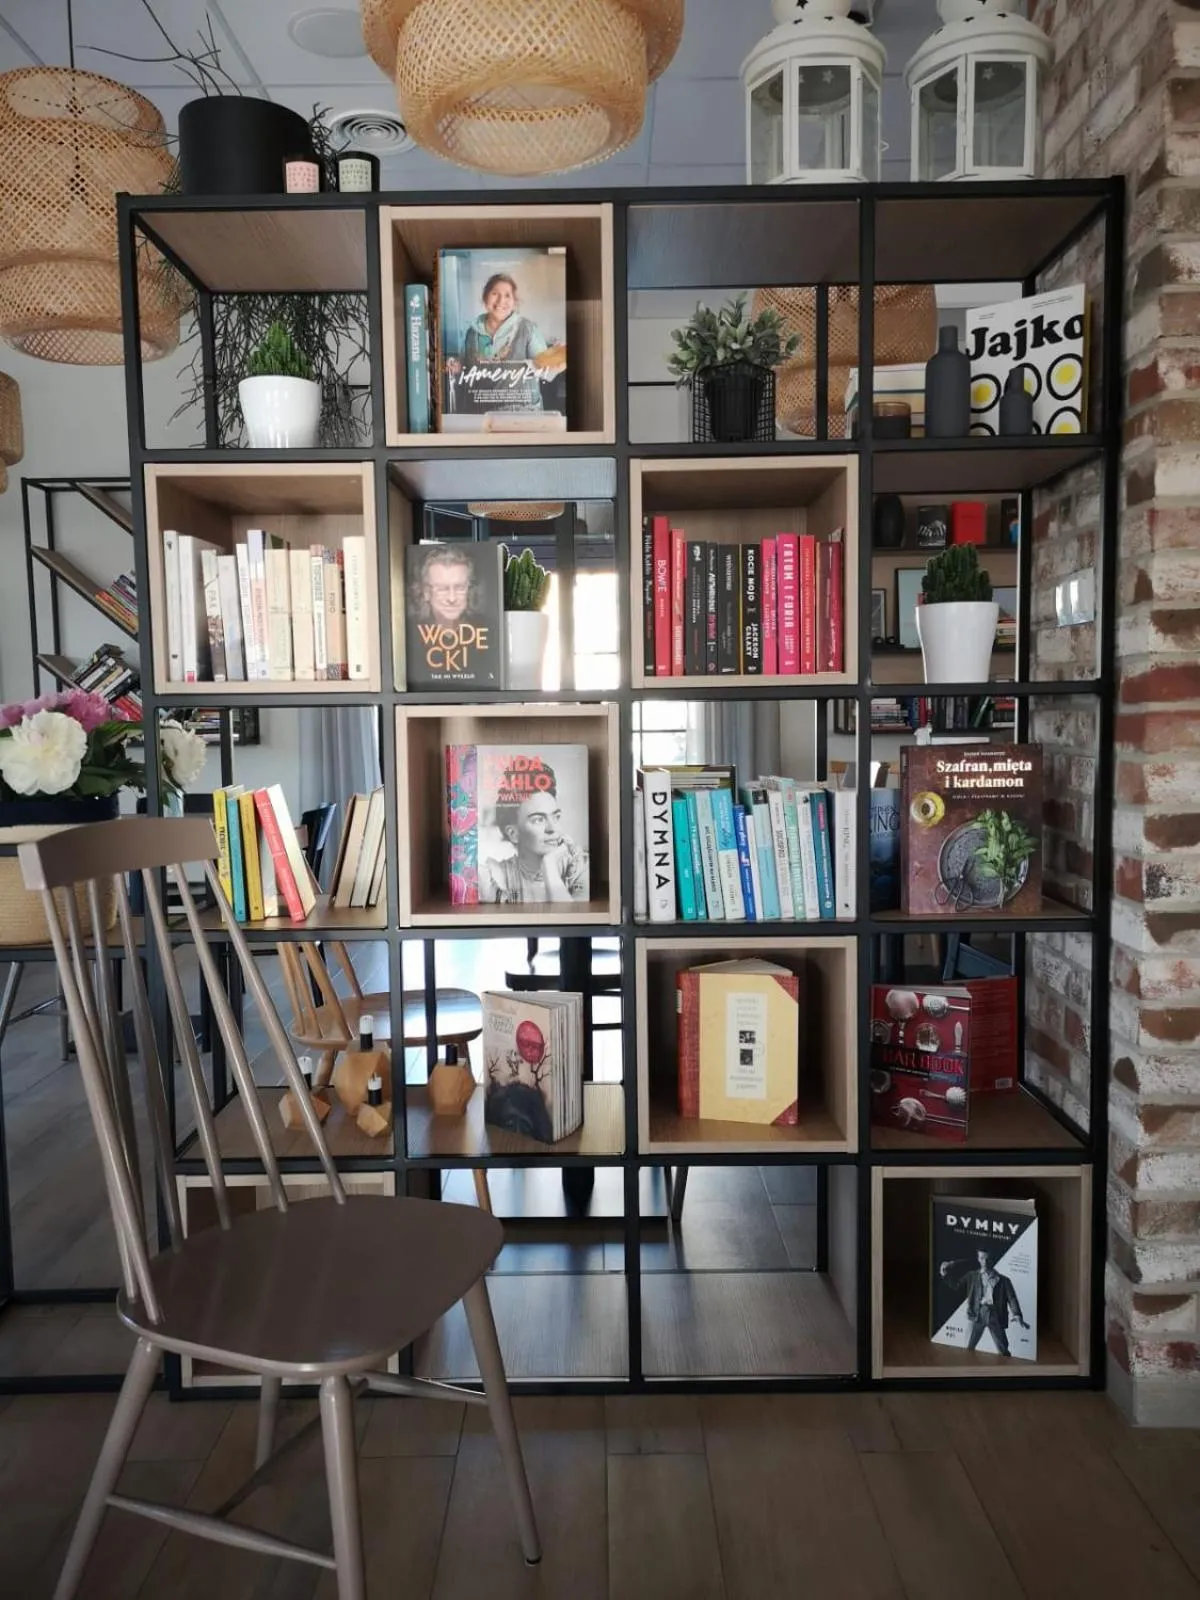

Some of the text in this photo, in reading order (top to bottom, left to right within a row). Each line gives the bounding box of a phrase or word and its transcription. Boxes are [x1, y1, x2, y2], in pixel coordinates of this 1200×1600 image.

[966, 314, 1084, 361] Jajko
[783, 543, 794, 581] FATUM
[747, 577, 755, 602] MOJO
[417, 623, 489, 650] WODE
[751, 622, 759, 659] JACKSON
[426, 645, 468, 671] CKI
[936, 758, 1032, 775] Szafran, mięta
[945, 774, 1024, 788] i kardamon
[652, 791, 671, 890] DYMNA
[946, 1214, 1020, 1235] DYMNY
